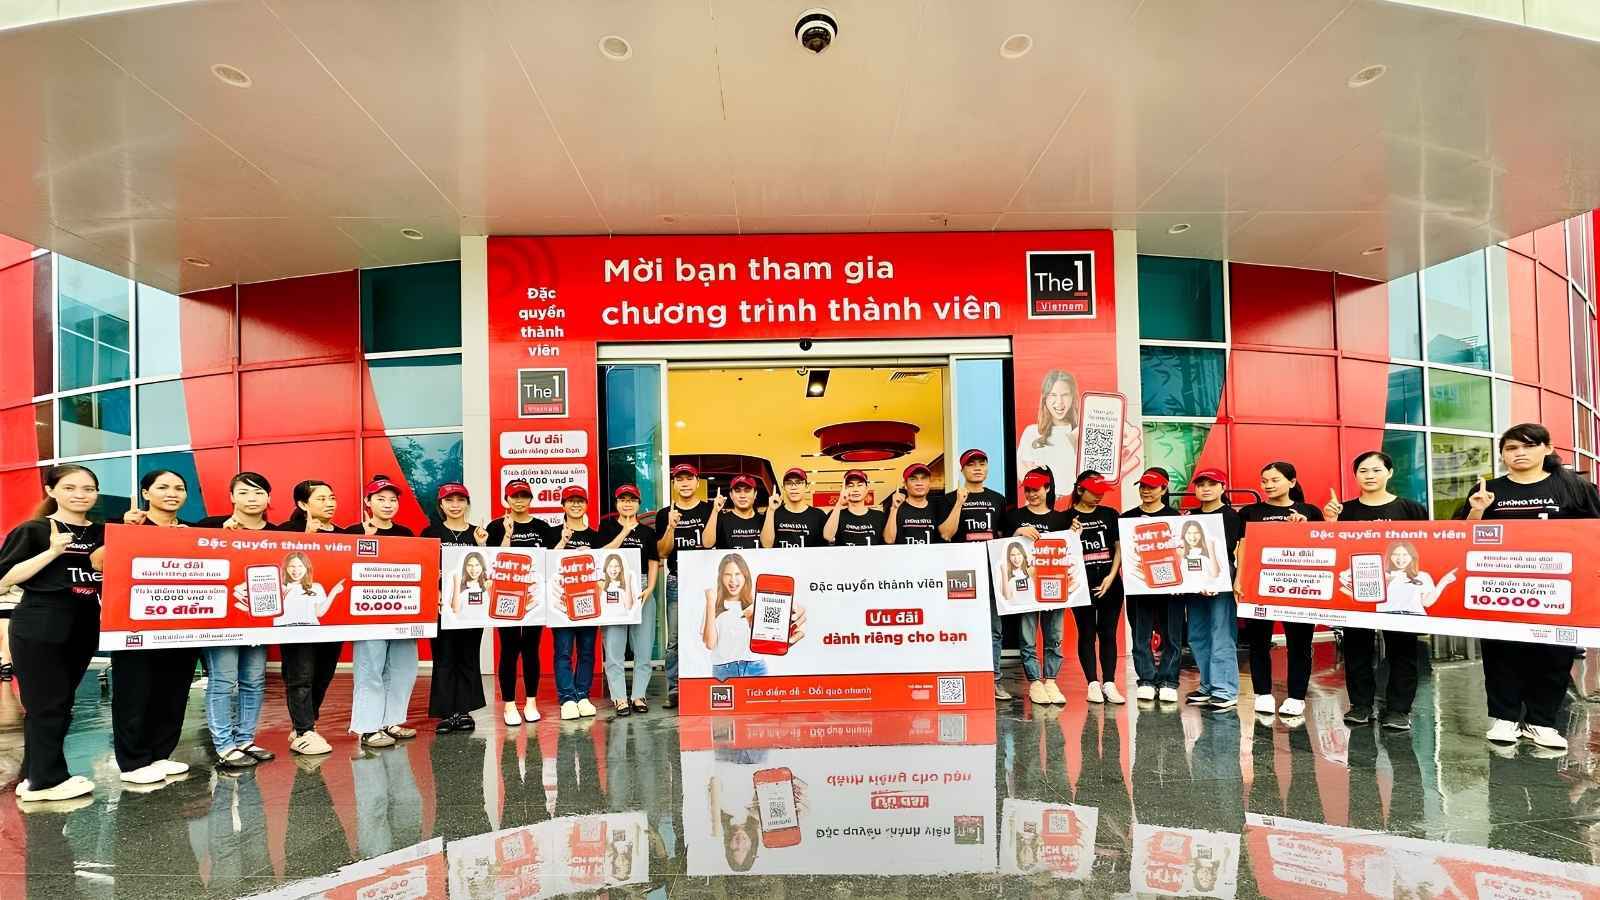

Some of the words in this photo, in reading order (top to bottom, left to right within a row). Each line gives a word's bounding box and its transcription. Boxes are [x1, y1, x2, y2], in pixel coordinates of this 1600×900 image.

[603, 256, 663, 283] Mời
[676, 256, 737, 287] bạn
[748, 255, 832, 282] tham
[844, 255, 894, 284] gia
[527, 287, 556, 301] Đặc
[518, 303, 566, 320] quyền
[601, 300, 727, 329] chương
[739, 297, 817, 323] trình
[829, 296, 921, 322] thành
[932, 295, 1001, 320] viên
[520, 324, 564, 339] thành
[527, 342, 560, 357] viên
[525, 433, 541, 445] Ưu
[545, 433, 563, 445] đãi
[538, 486, 563, 502] điể
[1311, 530, 1334, 540] Đặc
[1340, 530, 1381, 541] quyền
[1385, 529, 1428, 539] thành
[197, 537, 227, 550] Đặc
[232, 538, 277, 552] quyền
[282, 540, 320, 551] thành
[809, 580, 833, 593] Đặc
[836, 578, 875, 593] quyền
[879, 579, 914, 590] thành
[917, 578, 943, 590] viên
[1268, 585, 1285, 594] 50
[355, 602, 402, 611] 10.000
[1470, 594, 1540, 608] 10.000
[145, 605, 168, 616] 50
[869, 610, 891, 624] Ưu
[895, 610, 918, 624] đãi
[823, 632, 860, 645] dành
[864, 631, 903, 646] riêng
[907, 630, 935, 643] cho
[939, 630, 968, 645] bạn
